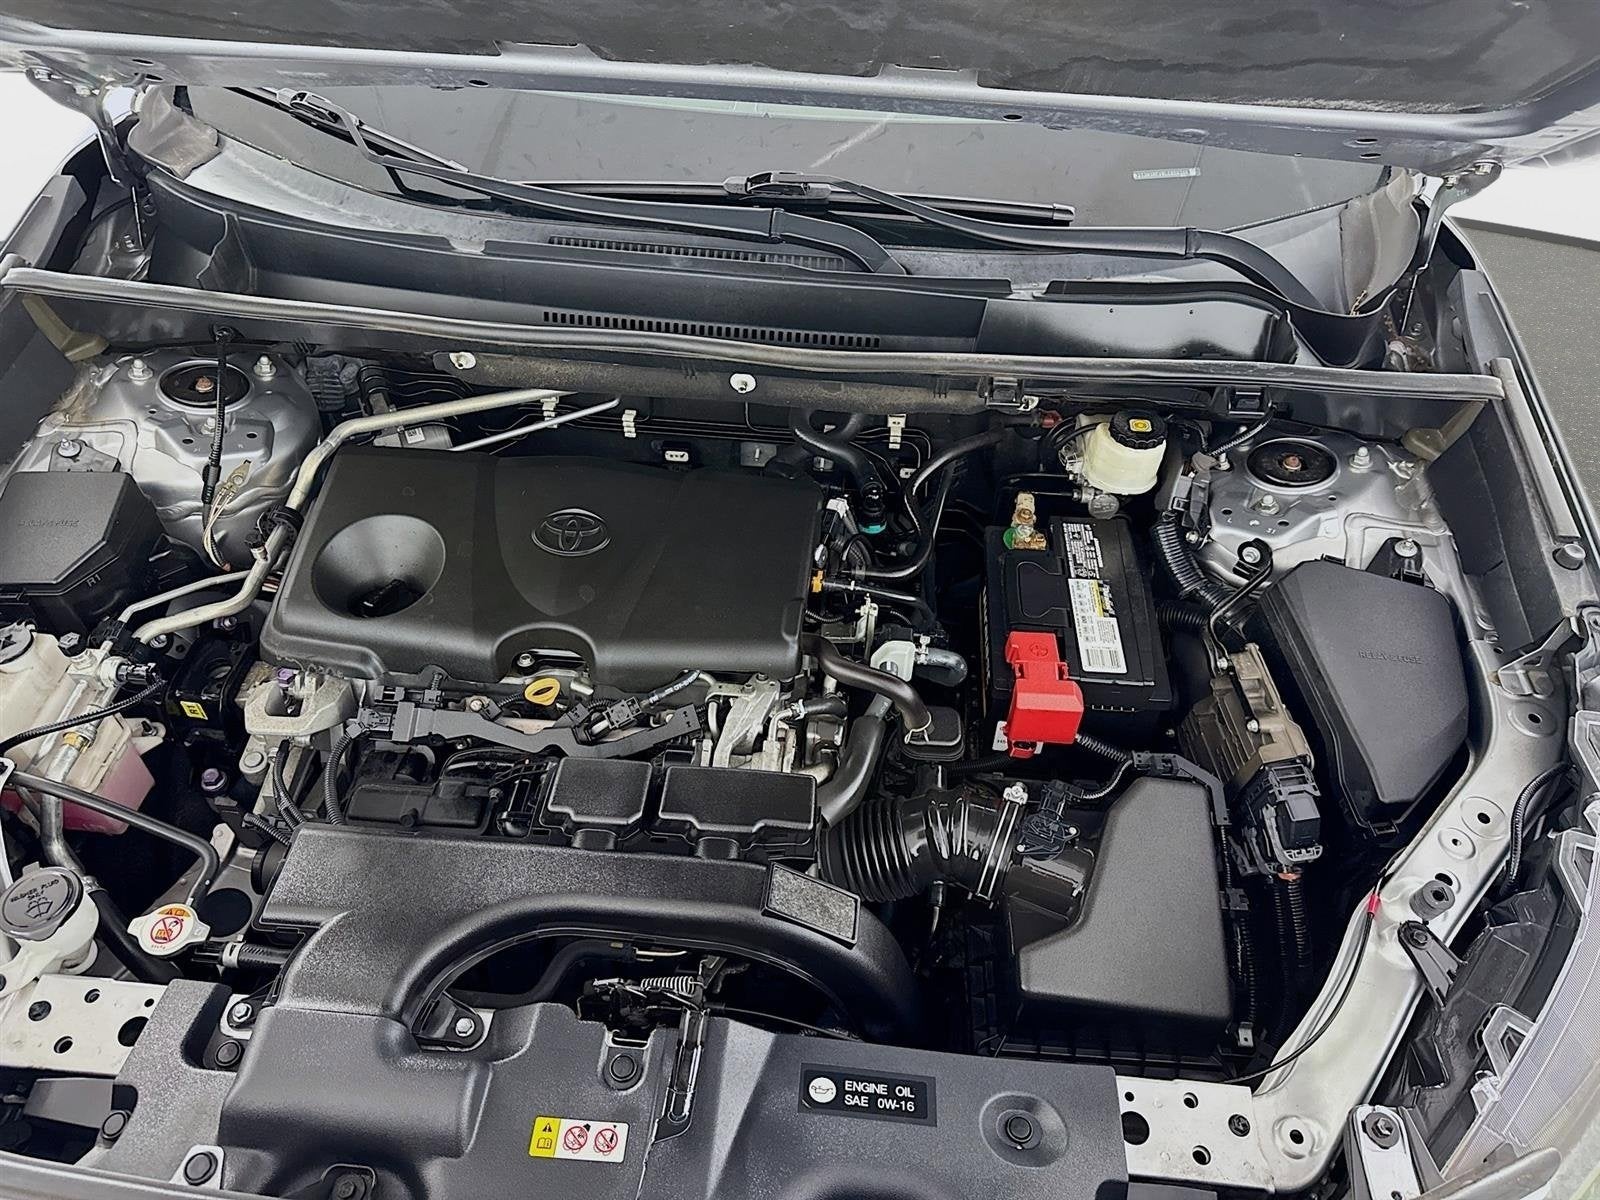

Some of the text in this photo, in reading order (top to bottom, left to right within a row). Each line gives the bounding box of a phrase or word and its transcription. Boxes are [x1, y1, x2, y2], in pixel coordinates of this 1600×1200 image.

[86, 573, 102, 588] R1
[844, 1080, 916, 1099] ENGINE OIL
[844, 1094, 915, 1112] SAE 0W-16
